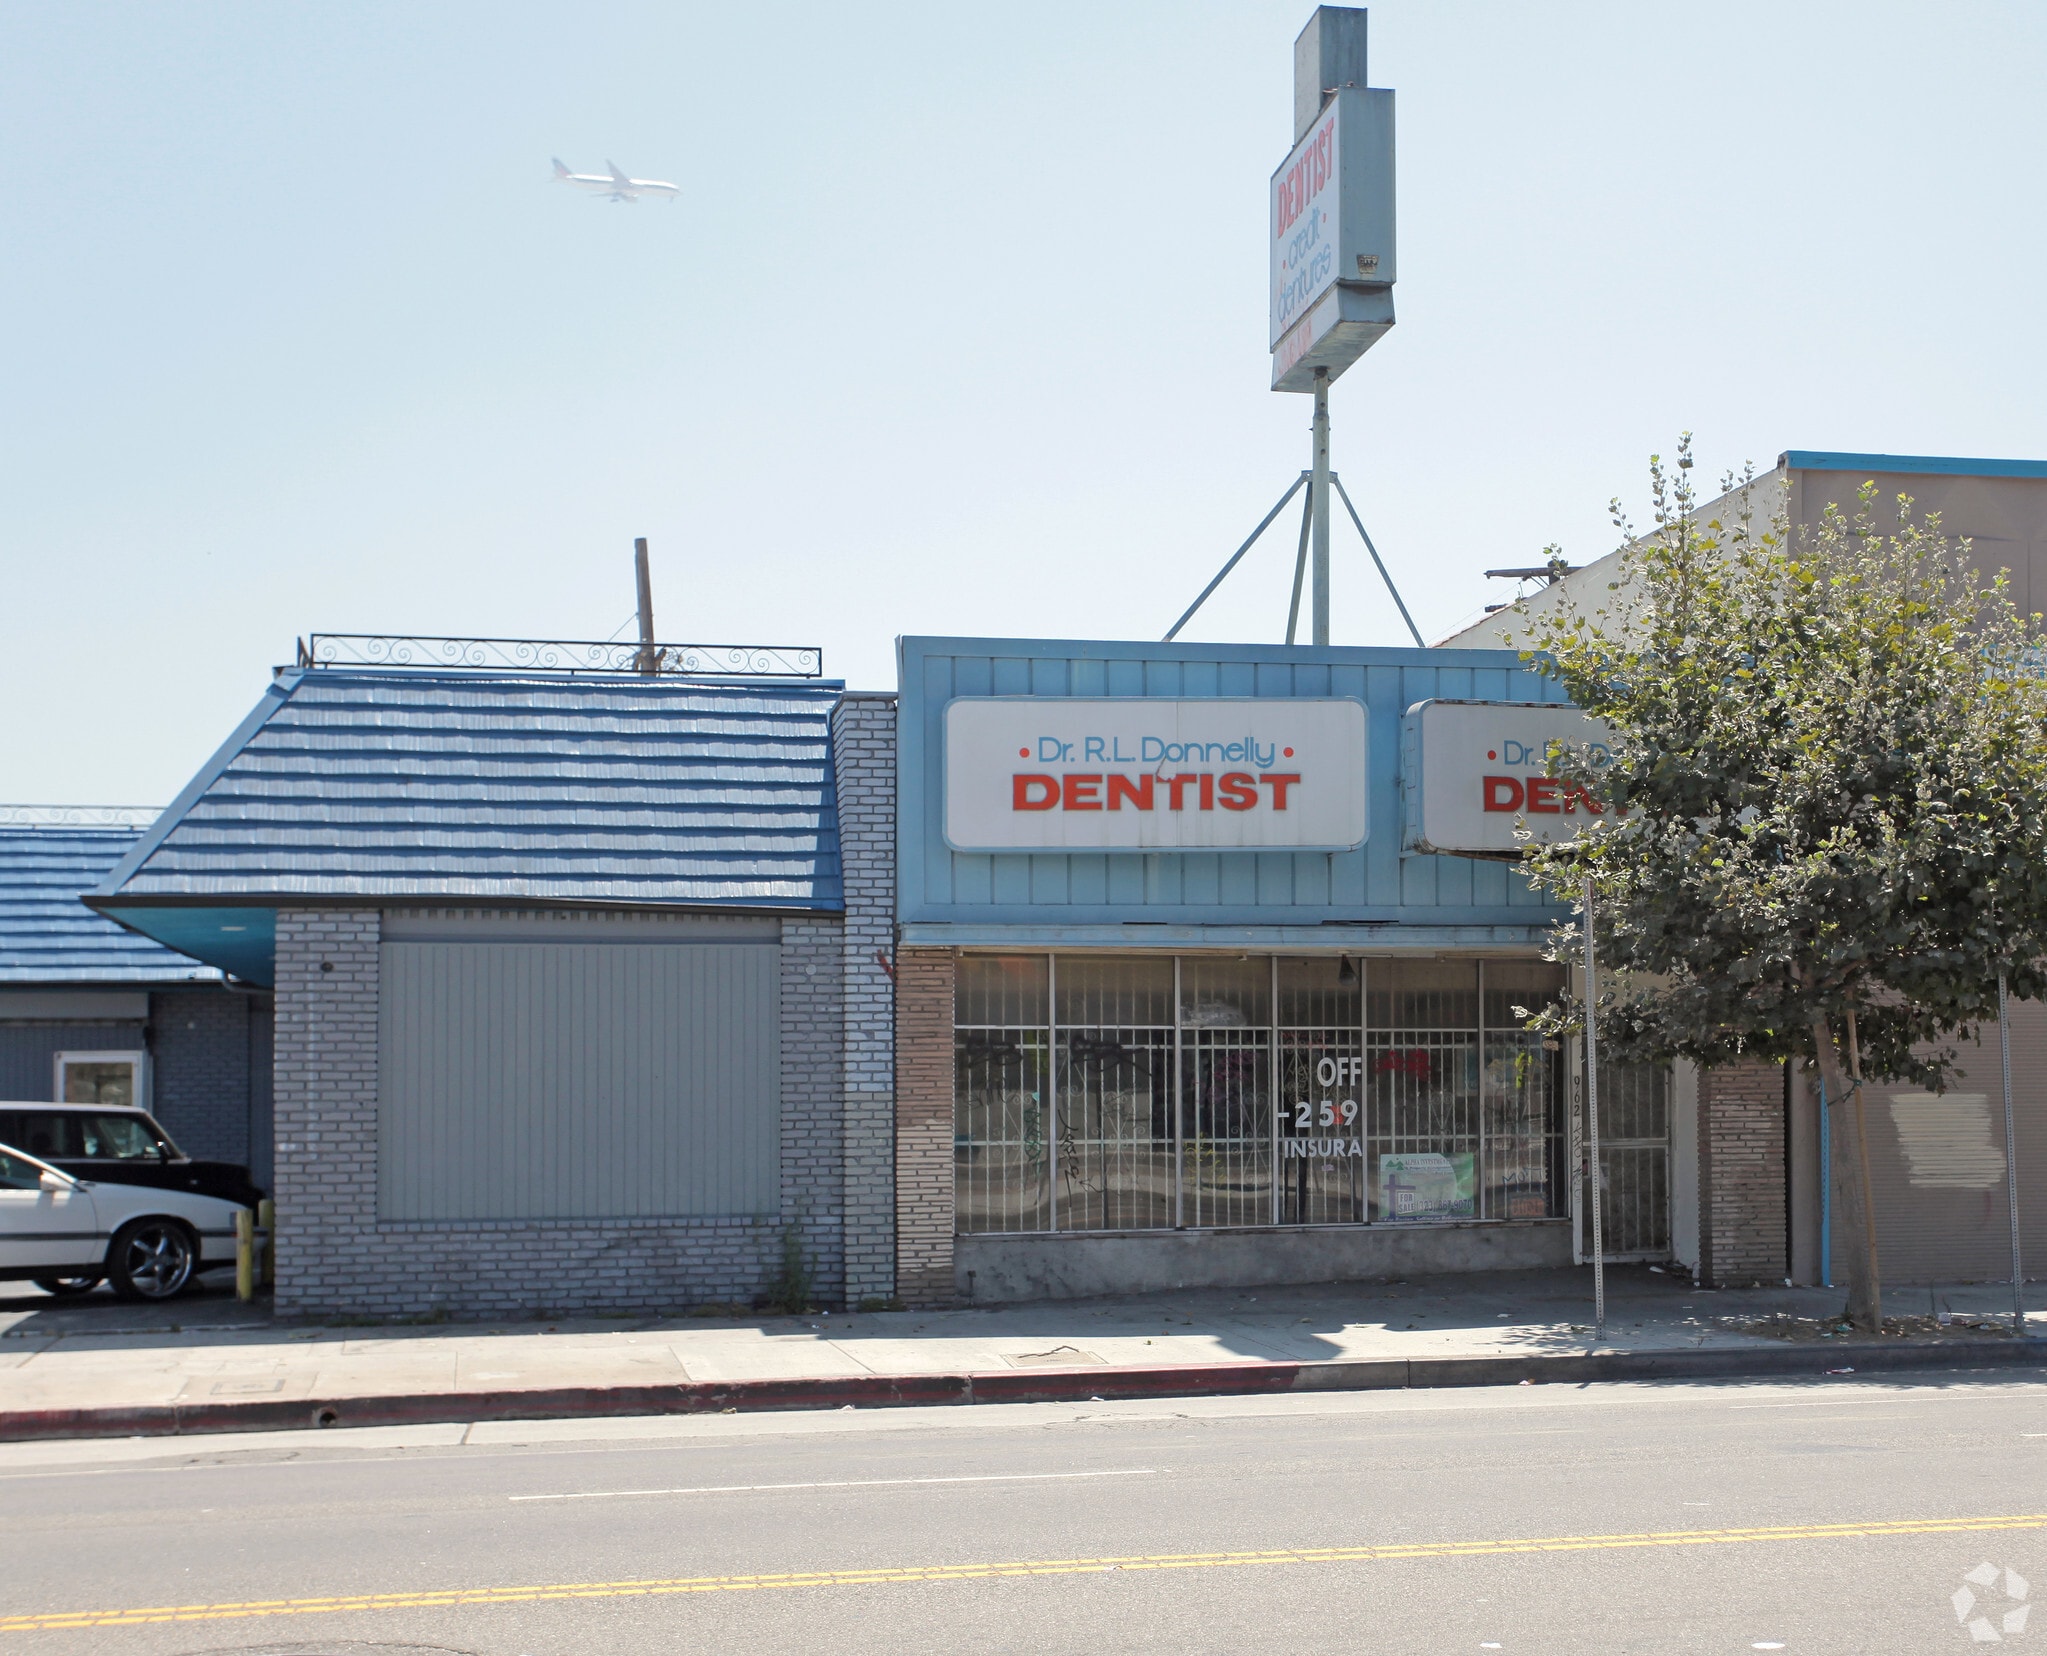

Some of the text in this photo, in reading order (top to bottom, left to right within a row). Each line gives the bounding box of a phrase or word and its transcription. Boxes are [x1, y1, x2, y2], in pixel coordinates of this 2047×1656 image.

[1277, 116, 1335, 240] DENTIST
[1277, 242, 1332, 324] dentures
[1038, 736, 1075, 763] Dr.
[1503, 740, 1536, 767] Dr.
[1012, 772, 1301, 811] DENTIST
[1316, 1057, 1362, 1088] OFF
[1284, 1138, 1363, 1159] INSURA
[1398, 1203, 1415, 1213] SALE
[1400, 1193, 1413, 1202] FOR
